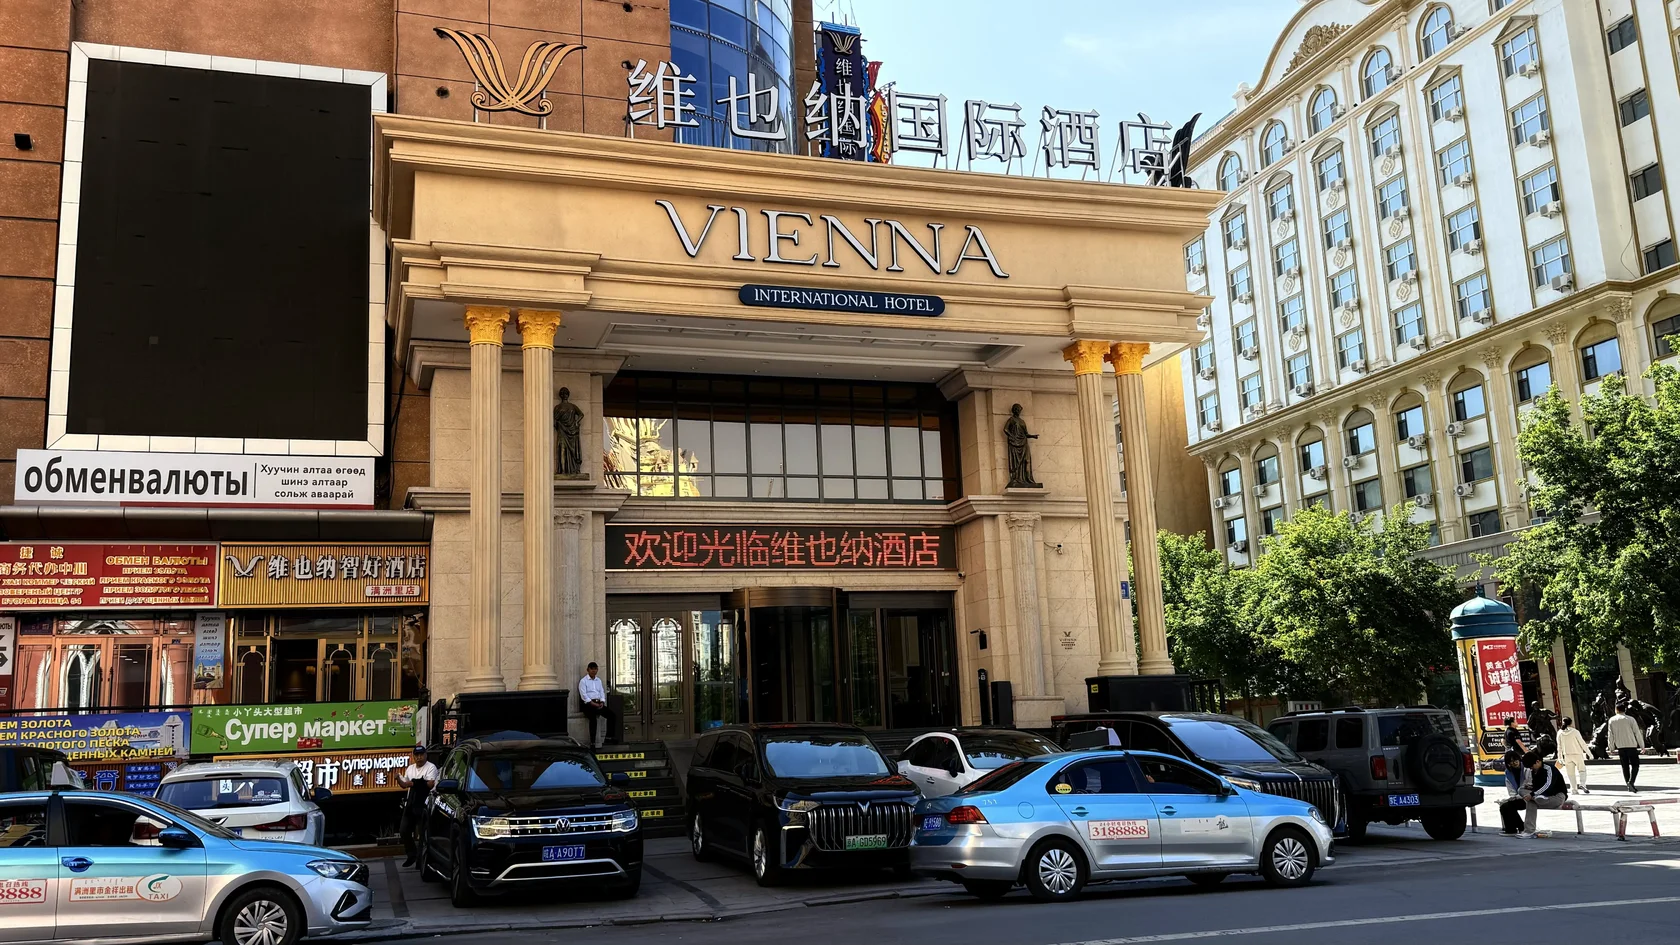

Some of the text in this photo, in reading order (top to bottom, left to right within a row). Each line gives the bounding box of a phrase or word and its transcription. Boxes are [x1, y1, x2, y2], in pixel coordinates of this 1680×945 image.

[626, 57, 1173, 175] 维也纳国际酒店
[655, 199, 1010, 278] VIENNA
[754, 288, 935, 312] INTERNATIONAL HOTEL
[24, 455, 248, 496] обменвалюты
[260, 464, 366, 476] Хуучин алтаа өгөөд
[281, 478, 348, 488] шинэ алтаар
[274, 490, 354, 500] сольж аваарай
[624, 530, 940, 567] 欢迎光临维也纳酒店
[105, 556, 150, 566] ОБМЕН
[267, 554, 427, 580] 维也纳智好酒店
[370, 586, 416, 595] 满洲里店
[233, 706, 303, 717] 小丫头大型超市
[21, 719, 72, 729] ЗОЛОТА
[20, 729, 88, 740] КРАСНОГО
[90, 727, 140, 737] ЗОЛОТА
[225, 718, 387, 745] Супер маркет
[89, 738, 130, 748] ПЕСКА
[120, 745, 173, 757] КАМНЕЙ
[342, 755, 410, 774] супер маркет
[1092, 825, 1147, 837] 3188888
